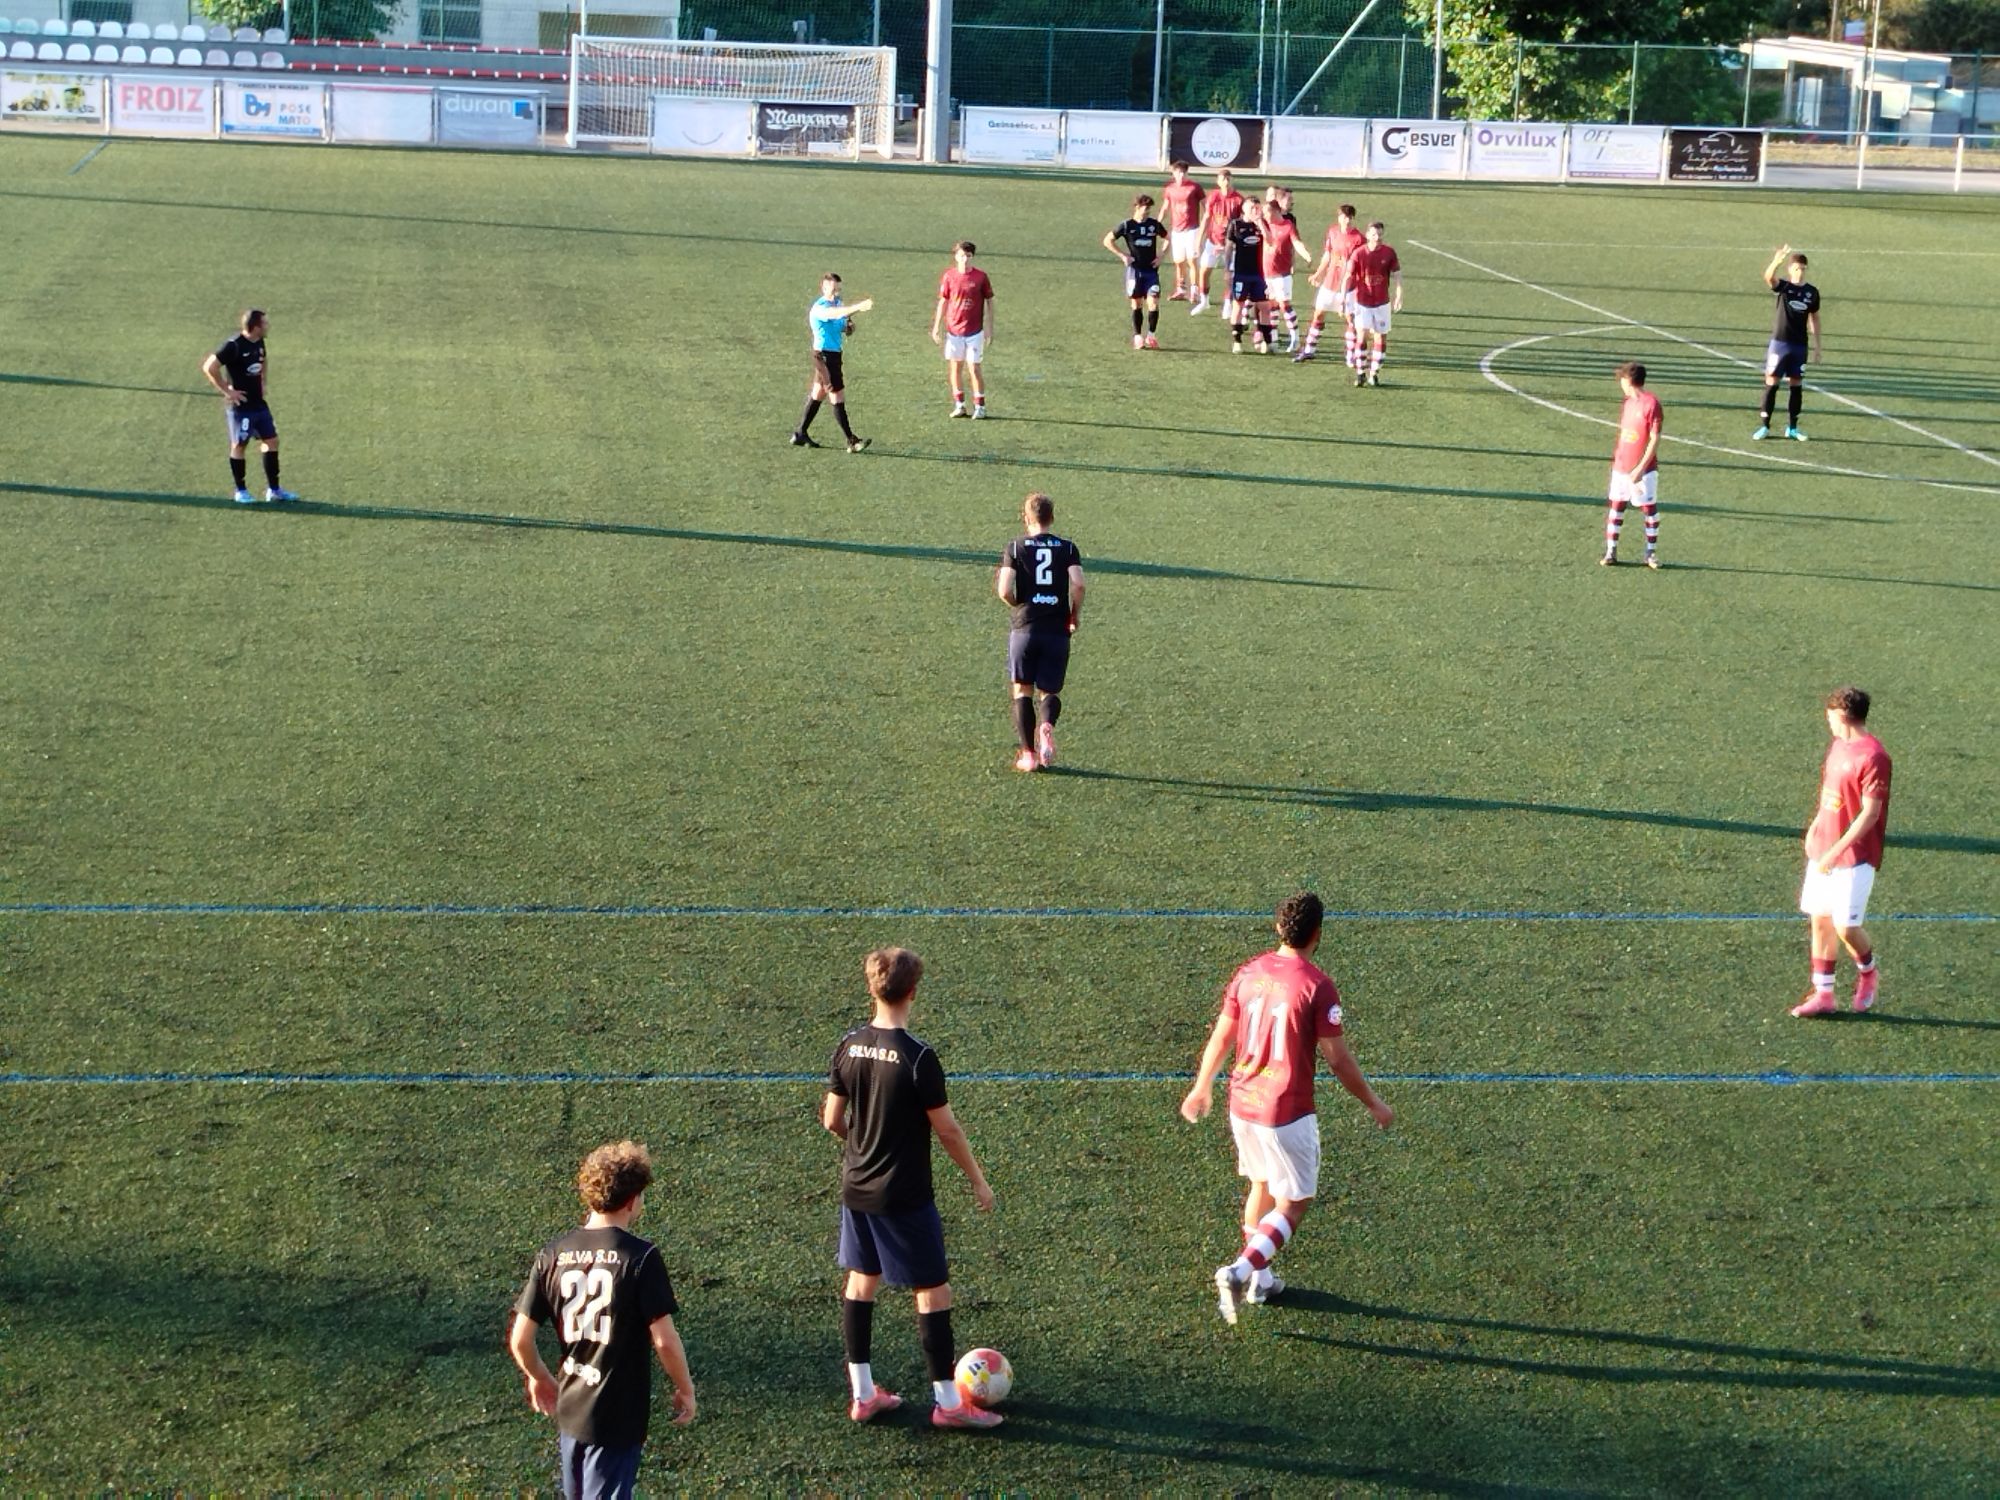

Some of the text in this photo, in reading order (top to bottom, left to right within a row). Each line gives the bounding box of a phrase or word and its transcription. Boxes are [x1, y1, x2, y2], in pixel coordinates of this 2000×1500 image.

[120, 84, 205, 113] FROIZ
[1477, 129, 1557, 148] Orvilux
[1202, 150, 1230, 160] FARO
[1035, 548, 1053, 585] 2
[1246, 997, 1290, 1062] 11
[556, 1250, 593, 1266] SILVA
[560, 1268, 614, 1345] 22
